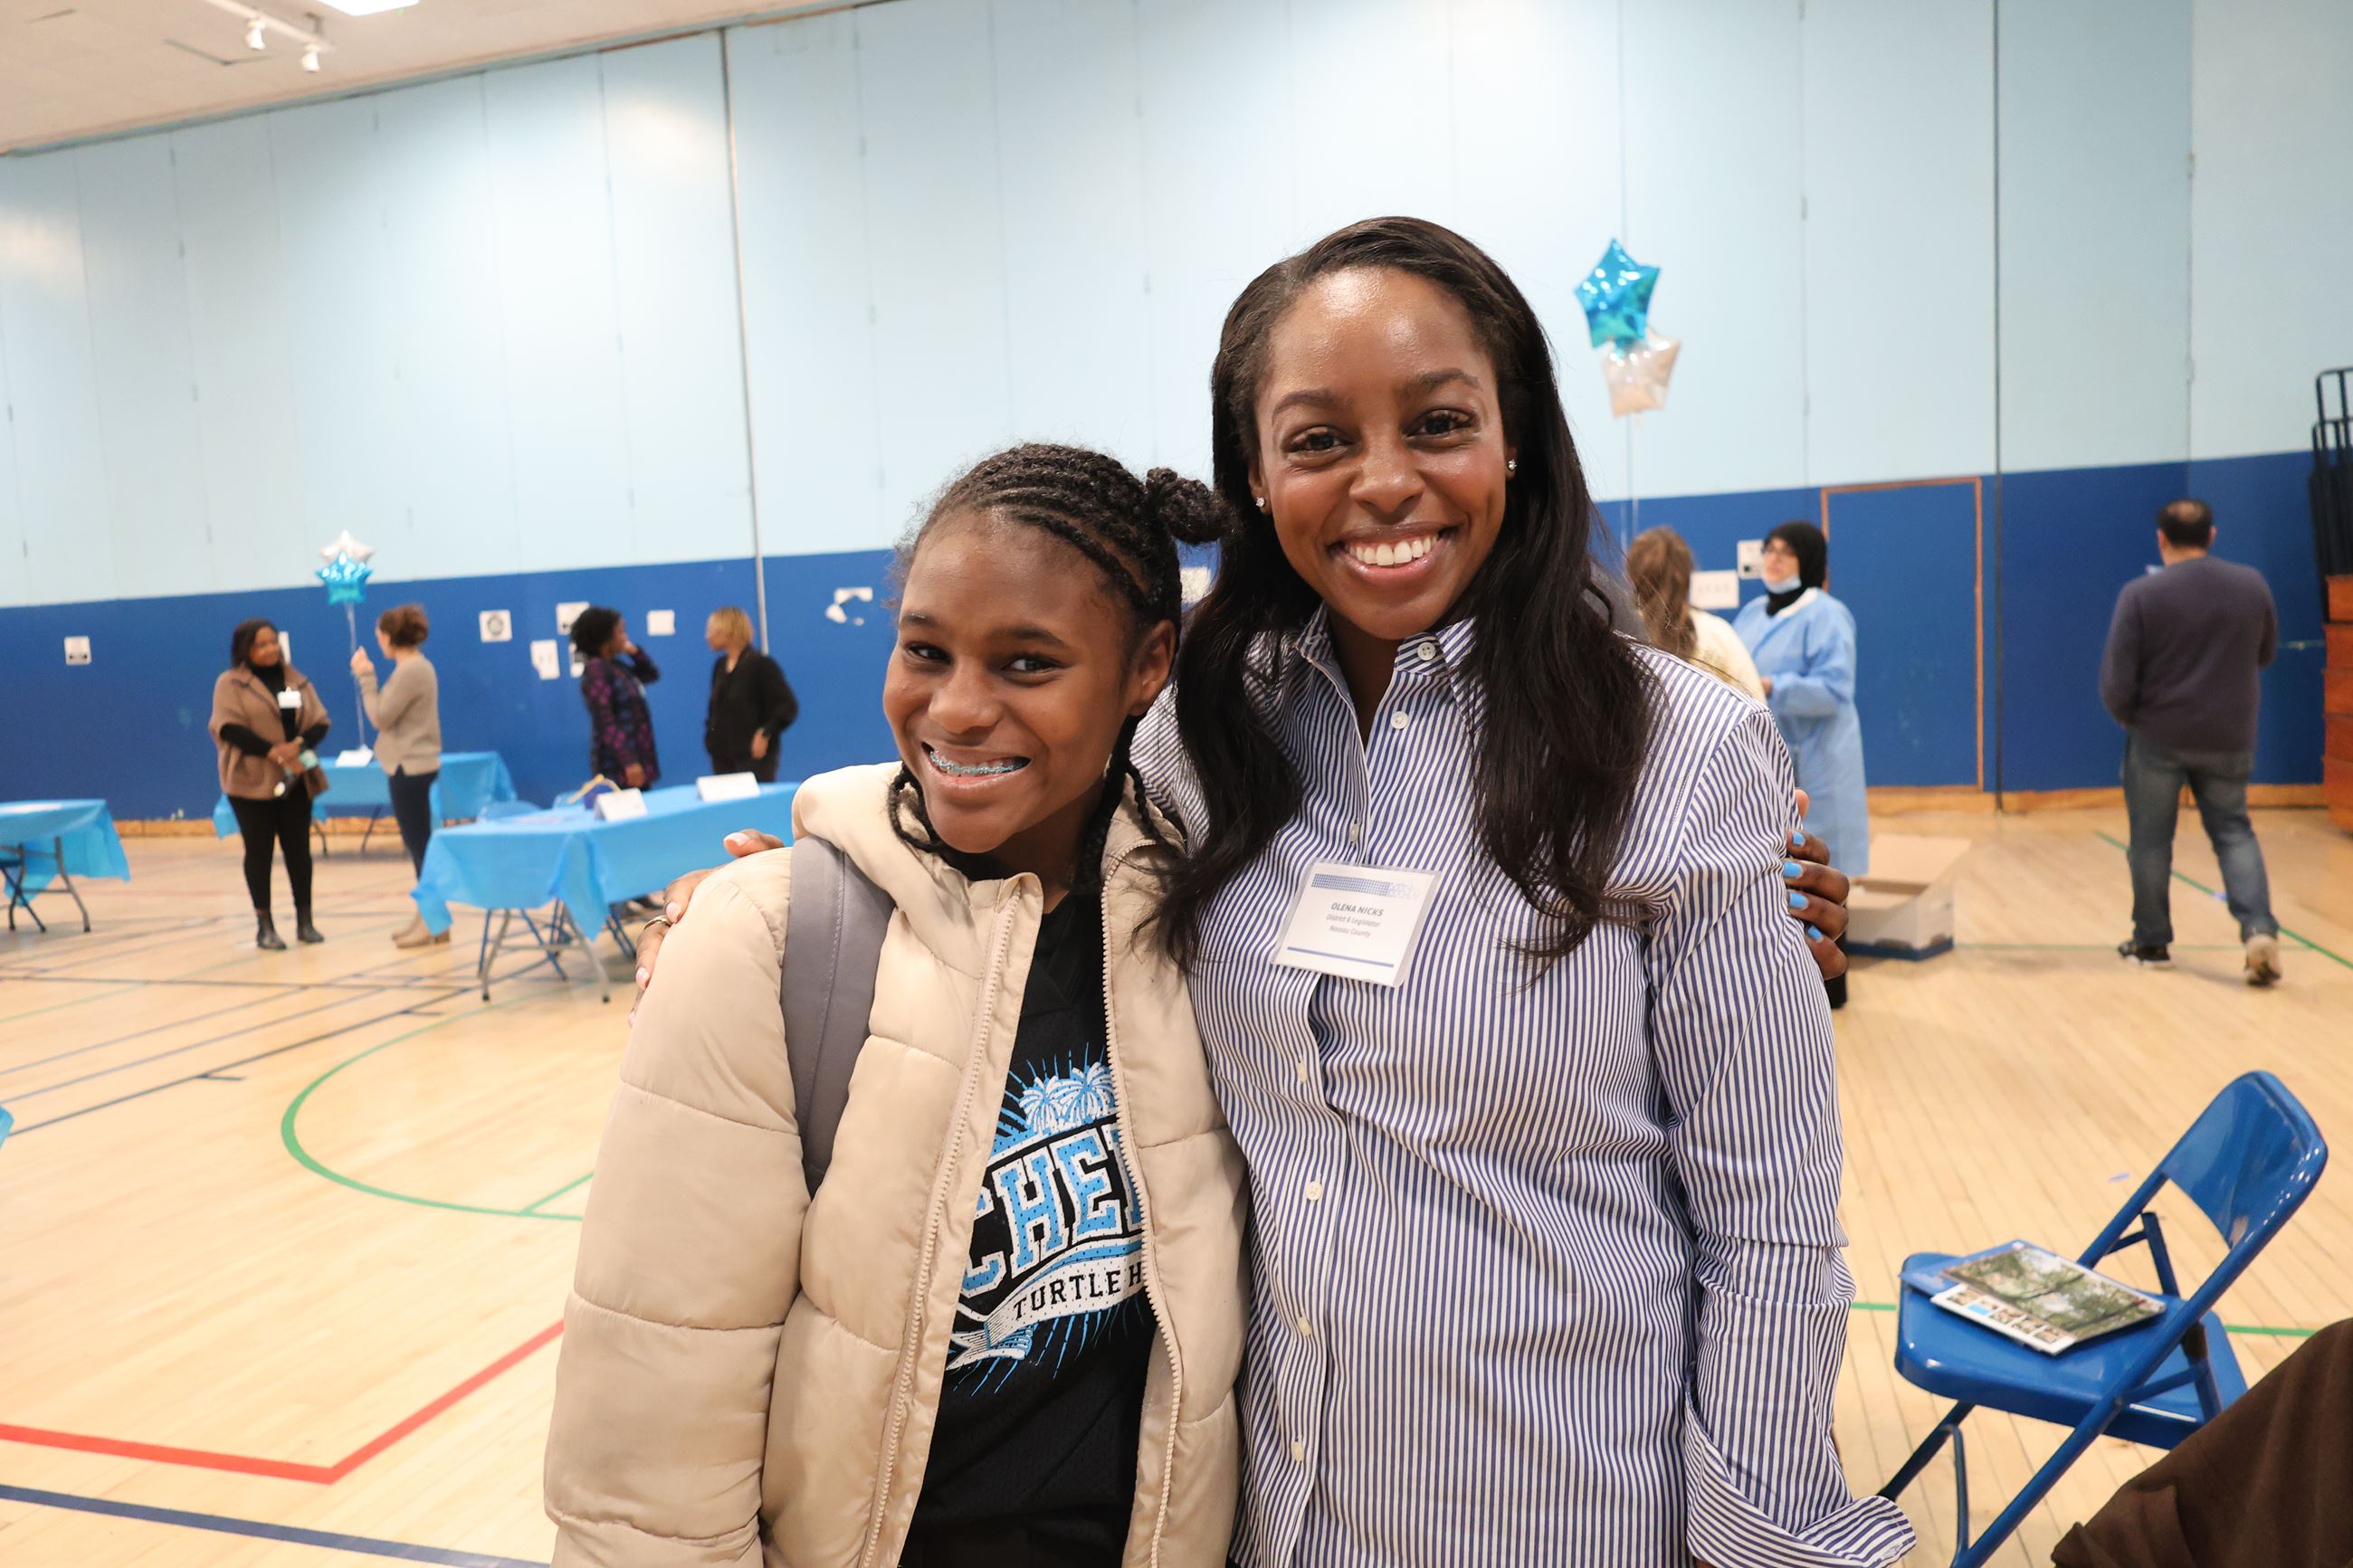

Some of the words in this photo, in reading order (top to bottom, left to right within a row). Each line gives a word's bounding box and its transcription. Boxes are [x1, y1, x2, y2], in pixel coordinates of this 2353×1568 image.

[1331, 902, 1357, 914] OLENA
[1358, 906, 1385, 917] NICKS
[1326, 914, 1347, 923] District
[1351, 917, 1381, 927] Legislator
[1329, 925, 1349, 935] Nassau
[1350, 927, 1371, 937] County
[1013, 1270, 1121, 1319] TURTLE
